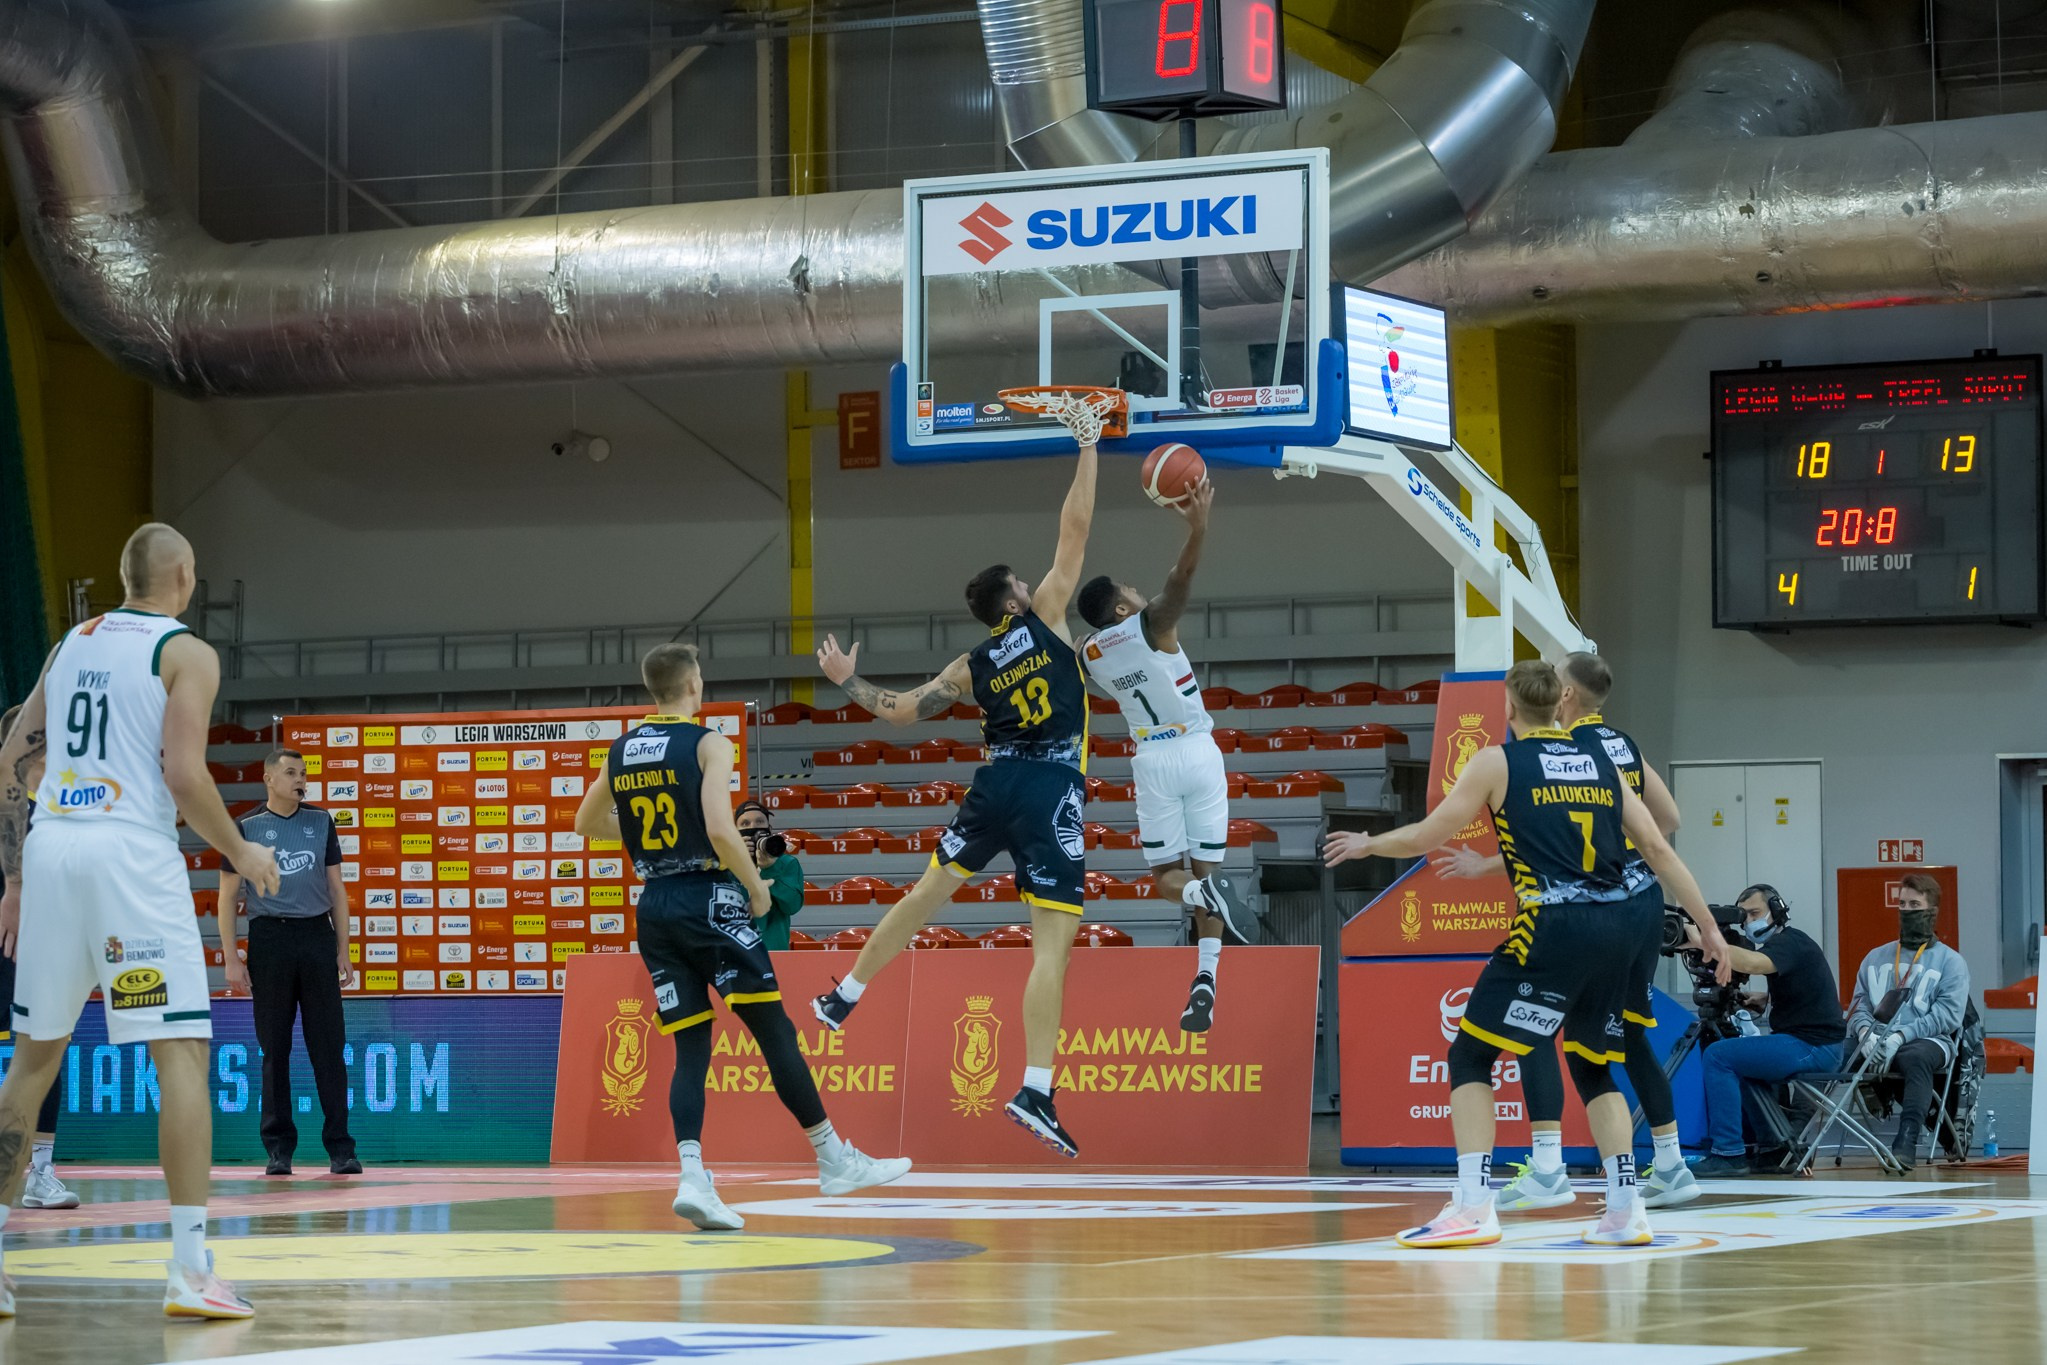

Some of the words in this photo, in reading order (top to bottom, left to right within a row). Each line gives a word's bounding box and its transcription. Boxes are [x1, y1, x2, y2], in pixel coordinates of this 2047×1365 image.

[1156, 0, 1201, 78] 8
[1247, 3, 1274, 84] 8
[1027, 194, 1256, 250] SUZUKI
[1275, 388, 1299, 396] Basket
[1227, 394, 1253, 404] Energa
[1275, 396, 1290, 404] Liga
[936, 406, 972, 418] molten
[848, 411, 870, 449] F
[1941, 435, 1976, 472] 13
[1797, 442, 1830, 478] 18
[1877, 450, 1885, 474] 1
[1423, 483, 1455, 522] Schelde
[1455, 515, 1481, 548] Sports
[1817, 507, 1897, 546] 20:8
[1841, 556, 1879, 572] TIME
[1883, 553, 1913, 570] OUT
[1967, 566, 1977, 600] 1
[1778, 573, 1799, 606] 4
[1004, 632, 1028, 653] Trefl
[990, 649, 1052, 694] OLEJNICZAK
[77, 669, 110, 690] WYKA
[1259, 696, 1274, 707] 17
[1331, 693, 1346, 704] 18
[1405, 691, 1419, 702] 19
[1010, 677, 1052, 729] 13
[1132, 689, 1160, 726] 1
[761, 713, 775, 723] 10
[836, 711, 848, 721] 11
[67, 691, 108, 760] 91
[255, 731, 262, 742] 2
[300, 732, 321, 740] Energa
[455, 725, 489, 743] LEGIA
[493, 723, 567, 742] WARSZAWA
[1268, 738, 1283, 748] 16
[1342, 736, 1356, 747] 17
[639, 742, 665, 755] Trefl
[1122, 743, 1136, 754] 14
[561, 753, 582, 761] Energa
[839, 752, 853, 763] 10
[910, 750, 921, 760] 11
[1561, 759, 1593, 775] Trefl
[237, 770, 243, 781] 3
[614, 770, 664, 792] KOLENDA
[373, 784, 394, 792] Energa
[486, 784, 505, 792] LOTOS
[1276, 783, 1291, 795] 17
[60, 785, 106, 806] LOTTO
[837, 795, 848, 805] 11
[908, 793, 922, 804] 12
[1532, 786, 1614, 808] PALIUKENAS
[766, 797, 780, 808] 10
[630, 792, 679, 850] 23
[447, 837, 468, 845] Energa
[832, 841, 847, 852] 12
[907, 839, 921, 850] 13
[1568, 811, 1596, 872] 7
[194, 857, 202, 868] 5
[283, 856, 309, 871] LOTTO
[523, 890, 544, 899] Energa
[829, 891, 843, 902] 13
[980, 888, 995, 899] 15
[1135, 885, 1150, 897] 17
[237, 902, 245, 913] 7
[1432, 902, 1506, 916] TRAMWAJE
[1432, 917, 1512, 931] WARSZAWS
[126, 948, 165, 961] BEMOWO
[486, 946, 507, 954] Energa
[601, 944, 623, 953] Energa
[215, 952, 223, 963] 8
[126, 973, 151, 984] ELE
[1527, 1011, 1559, 1031] Trefl
[1056, 1028, 1208, 1055] RAMWAJE
[1409, 1055, 1521, 1091] Enga
[1410, 1105, 1453, 1119] GRUP
